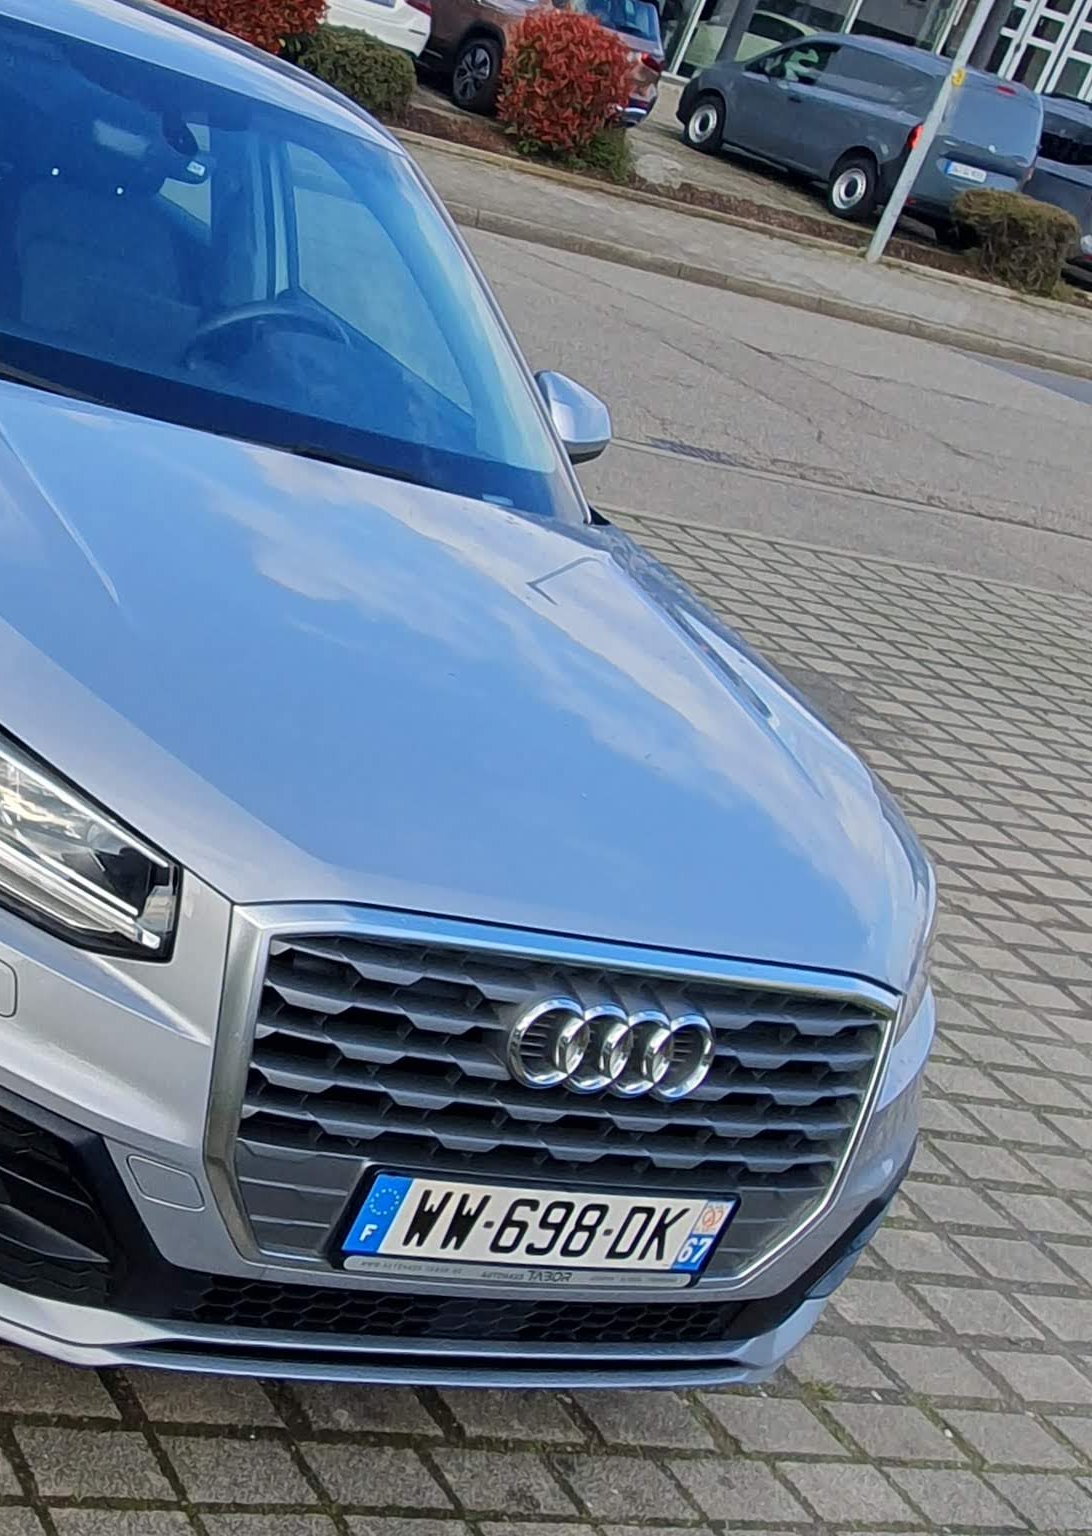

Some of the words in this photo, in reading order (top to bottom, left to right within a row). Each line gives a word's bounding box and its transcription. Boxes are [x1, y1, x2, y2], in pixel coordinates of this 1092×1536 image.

[358, 1224, 377, 1242] F
[402, 1189, 691, 1261] WW-698-DK
[677, 1237, 714, 1263] 67
[526, 1269, 573, 1283] TABOR
